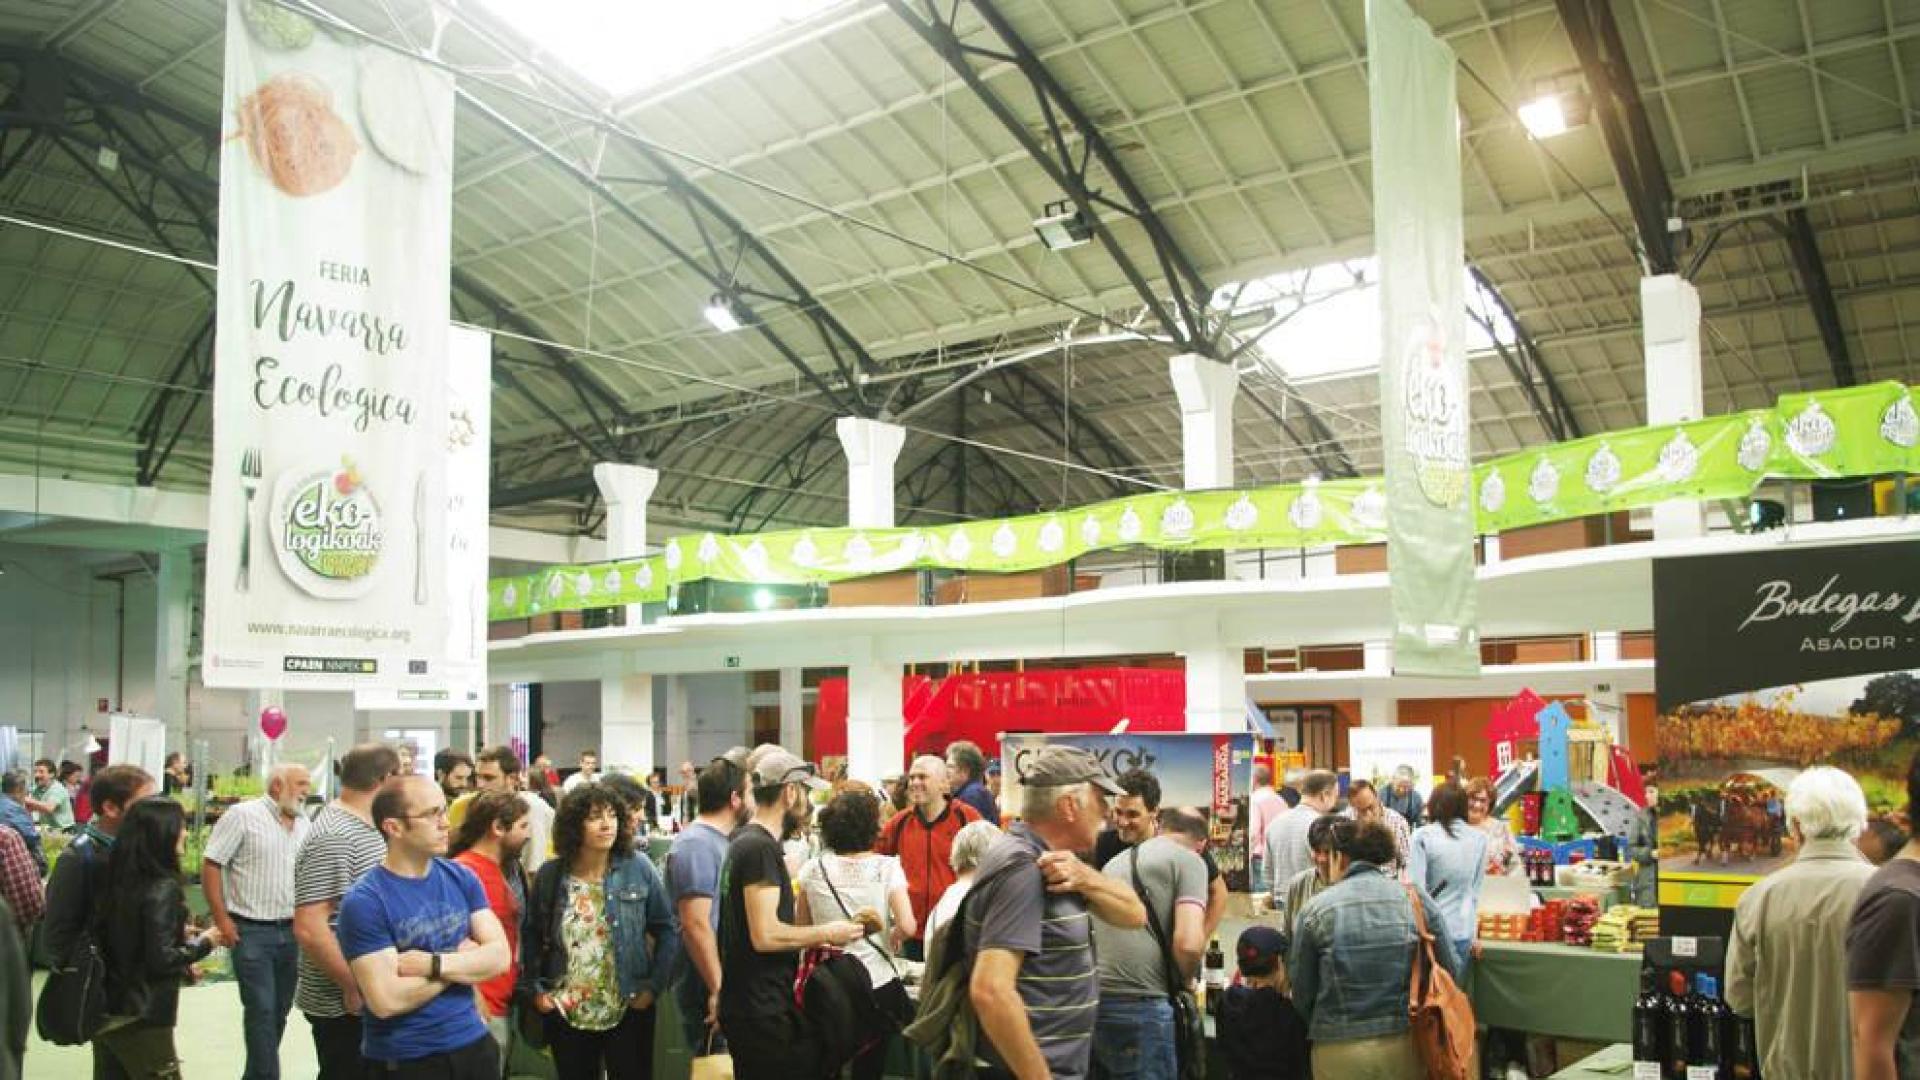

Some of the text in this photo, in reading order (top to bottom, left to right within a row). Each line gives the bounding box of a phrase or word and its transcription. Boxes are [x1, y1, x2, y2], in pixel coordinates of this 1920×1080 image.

[320, 260, 370, 287] FERIA
[249, 278, 408, 355] Navarra
[254, 356, 418, 432] Ecologica
[289, 481, 371, 530] eko-
[1737, 573, 1906, 632] Bodegas
[1800, 635, 1896, 652] ASADOR
